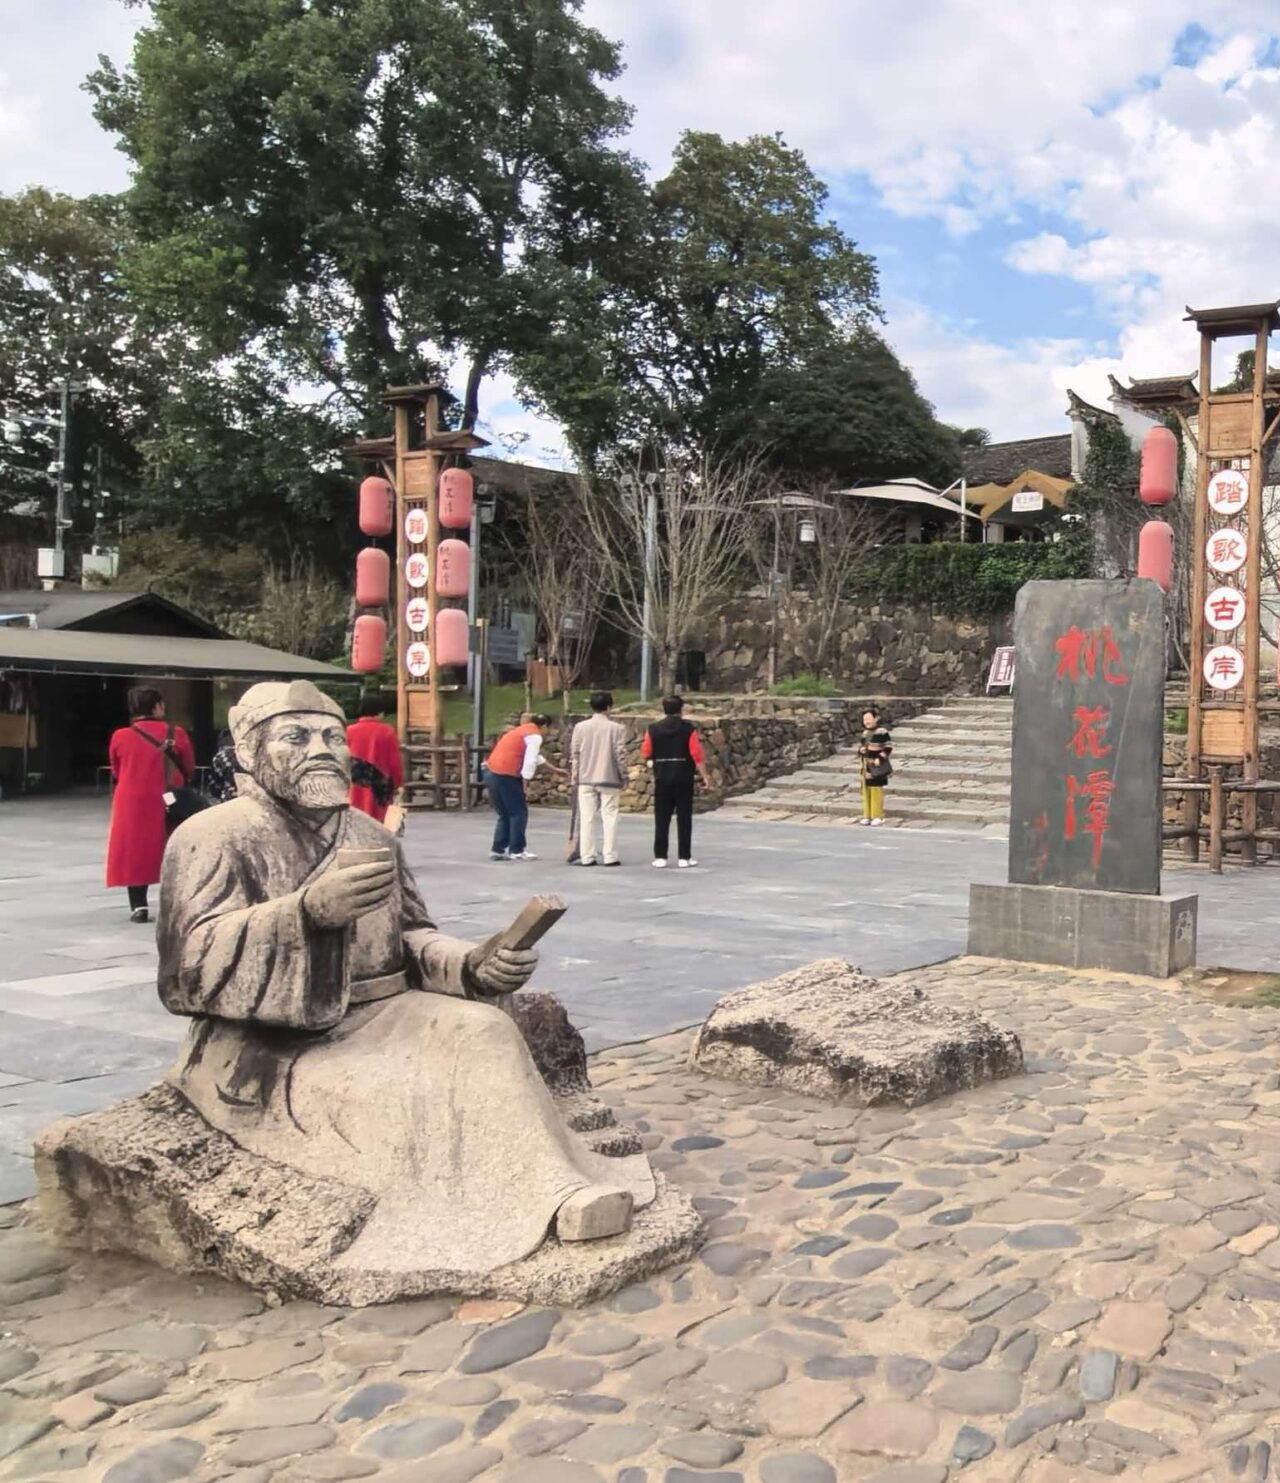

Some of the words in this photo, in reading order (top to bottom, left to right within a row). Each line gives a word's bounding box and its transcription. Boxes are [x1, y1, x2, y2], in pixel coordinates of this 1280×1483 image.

[1210, 480, 1244, 680] 踏歌古岸
[1055, 624, 1129, 868] 桃花潭
